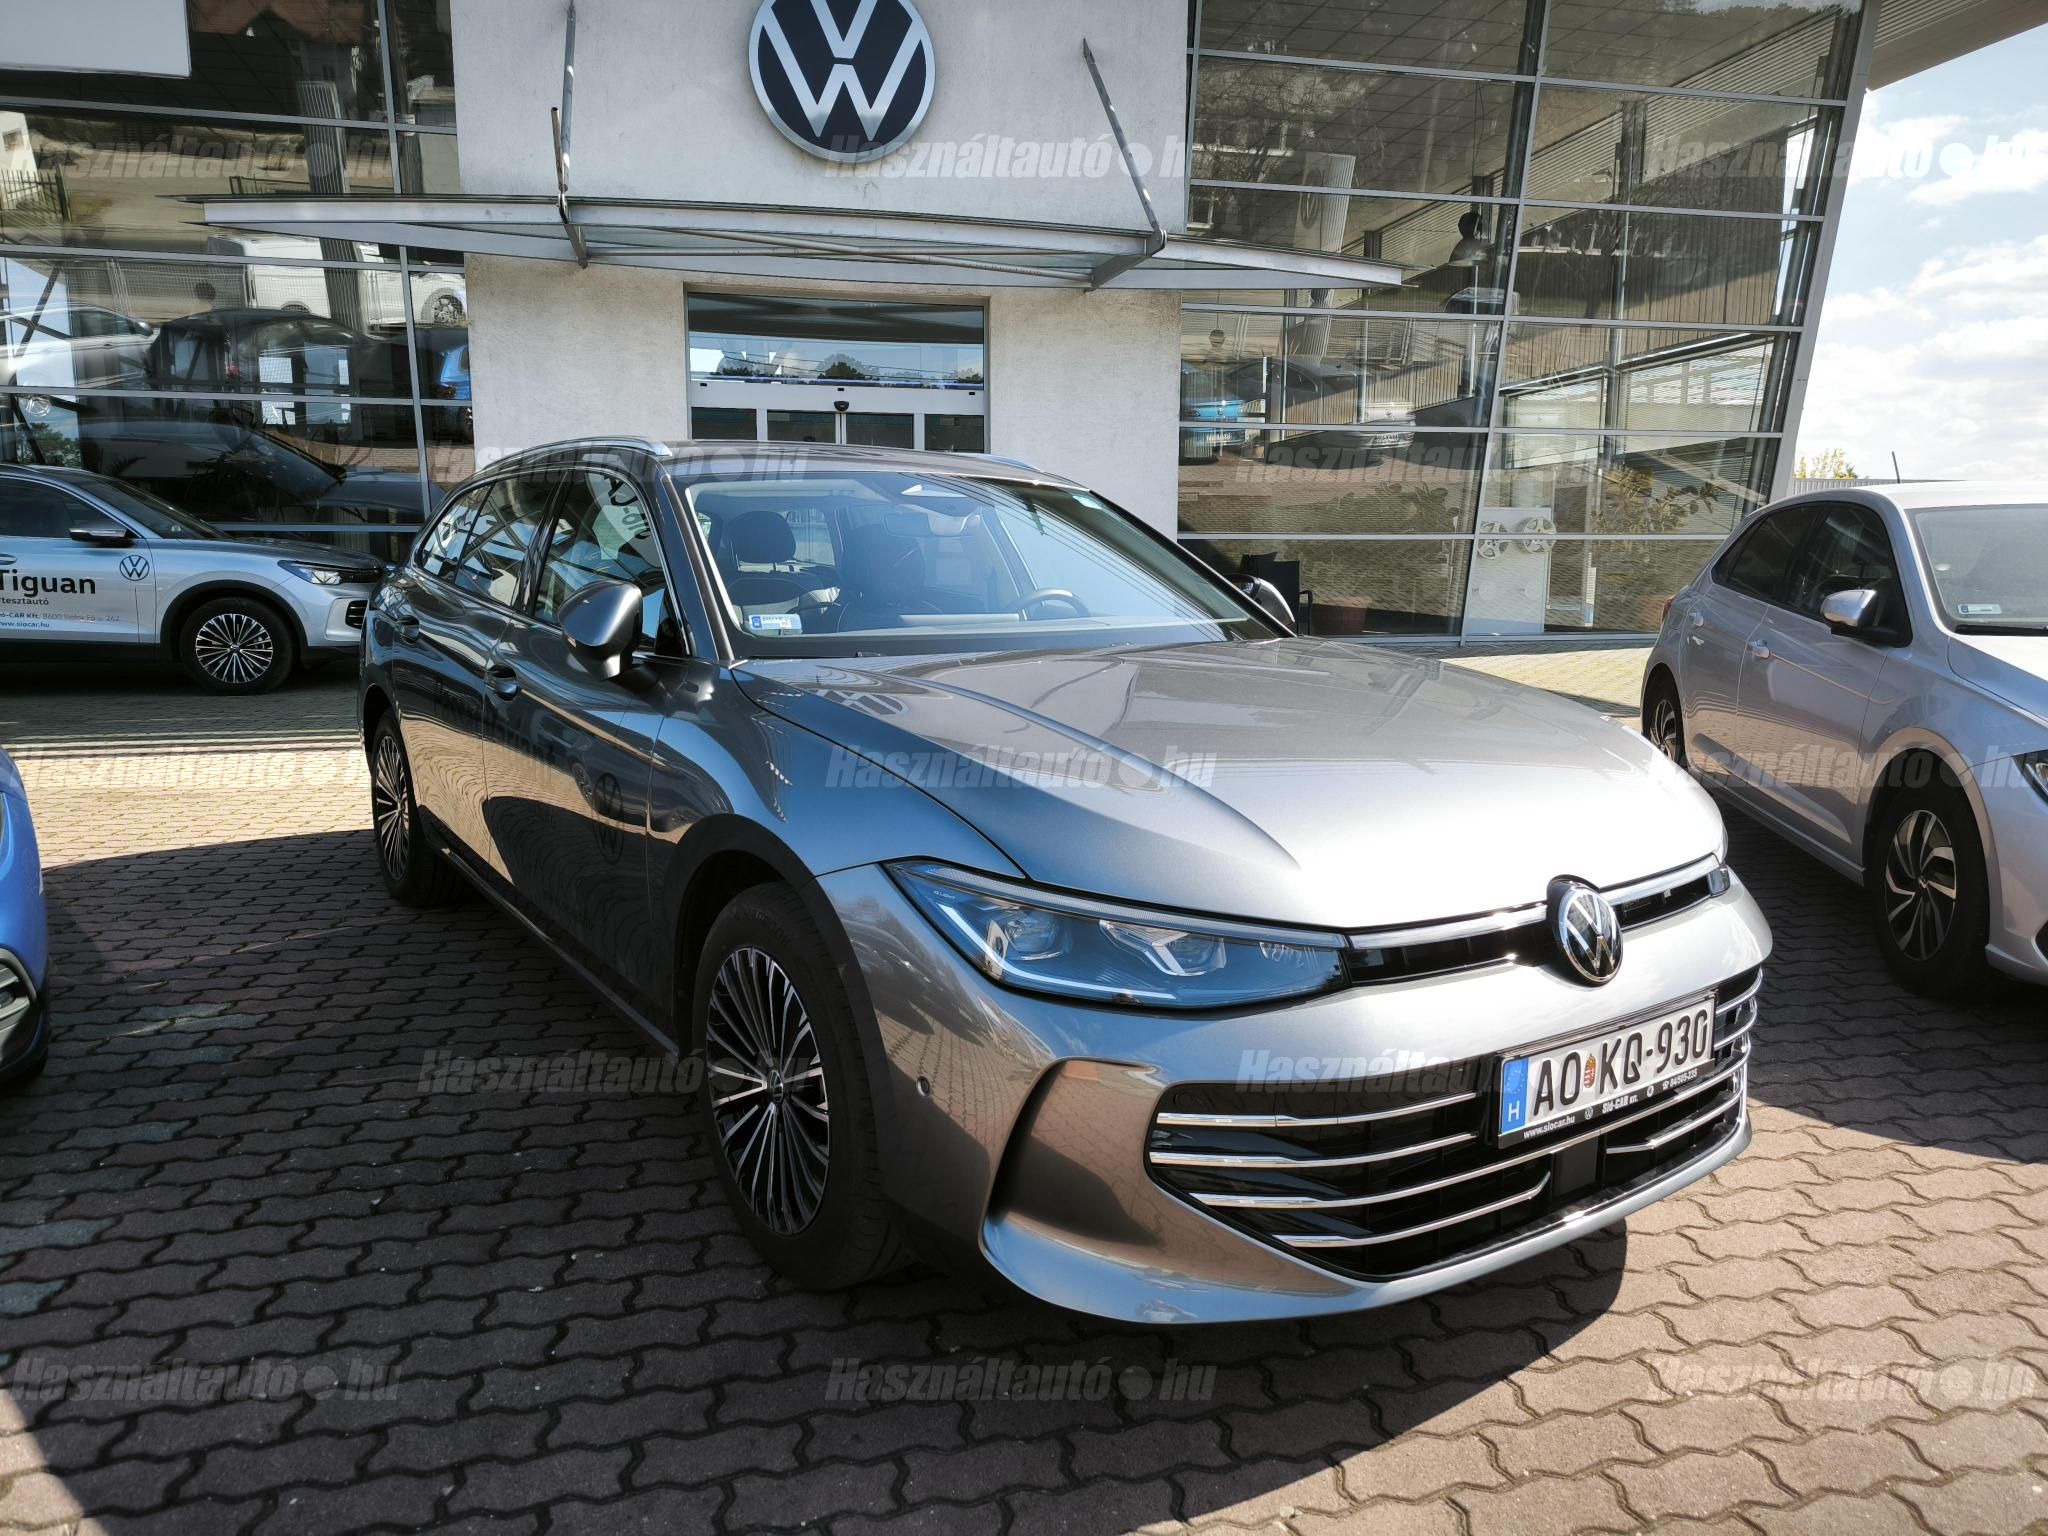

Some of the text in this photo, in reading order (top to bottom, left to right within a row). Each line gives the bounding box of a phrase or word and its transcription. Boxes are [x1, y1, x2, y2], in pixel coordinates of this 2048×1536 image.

[0, 569, 96, 597] Tiguan
[1534, 1051, 1581, 1117] AO
[1508, 1101, 1520, 1122] H
